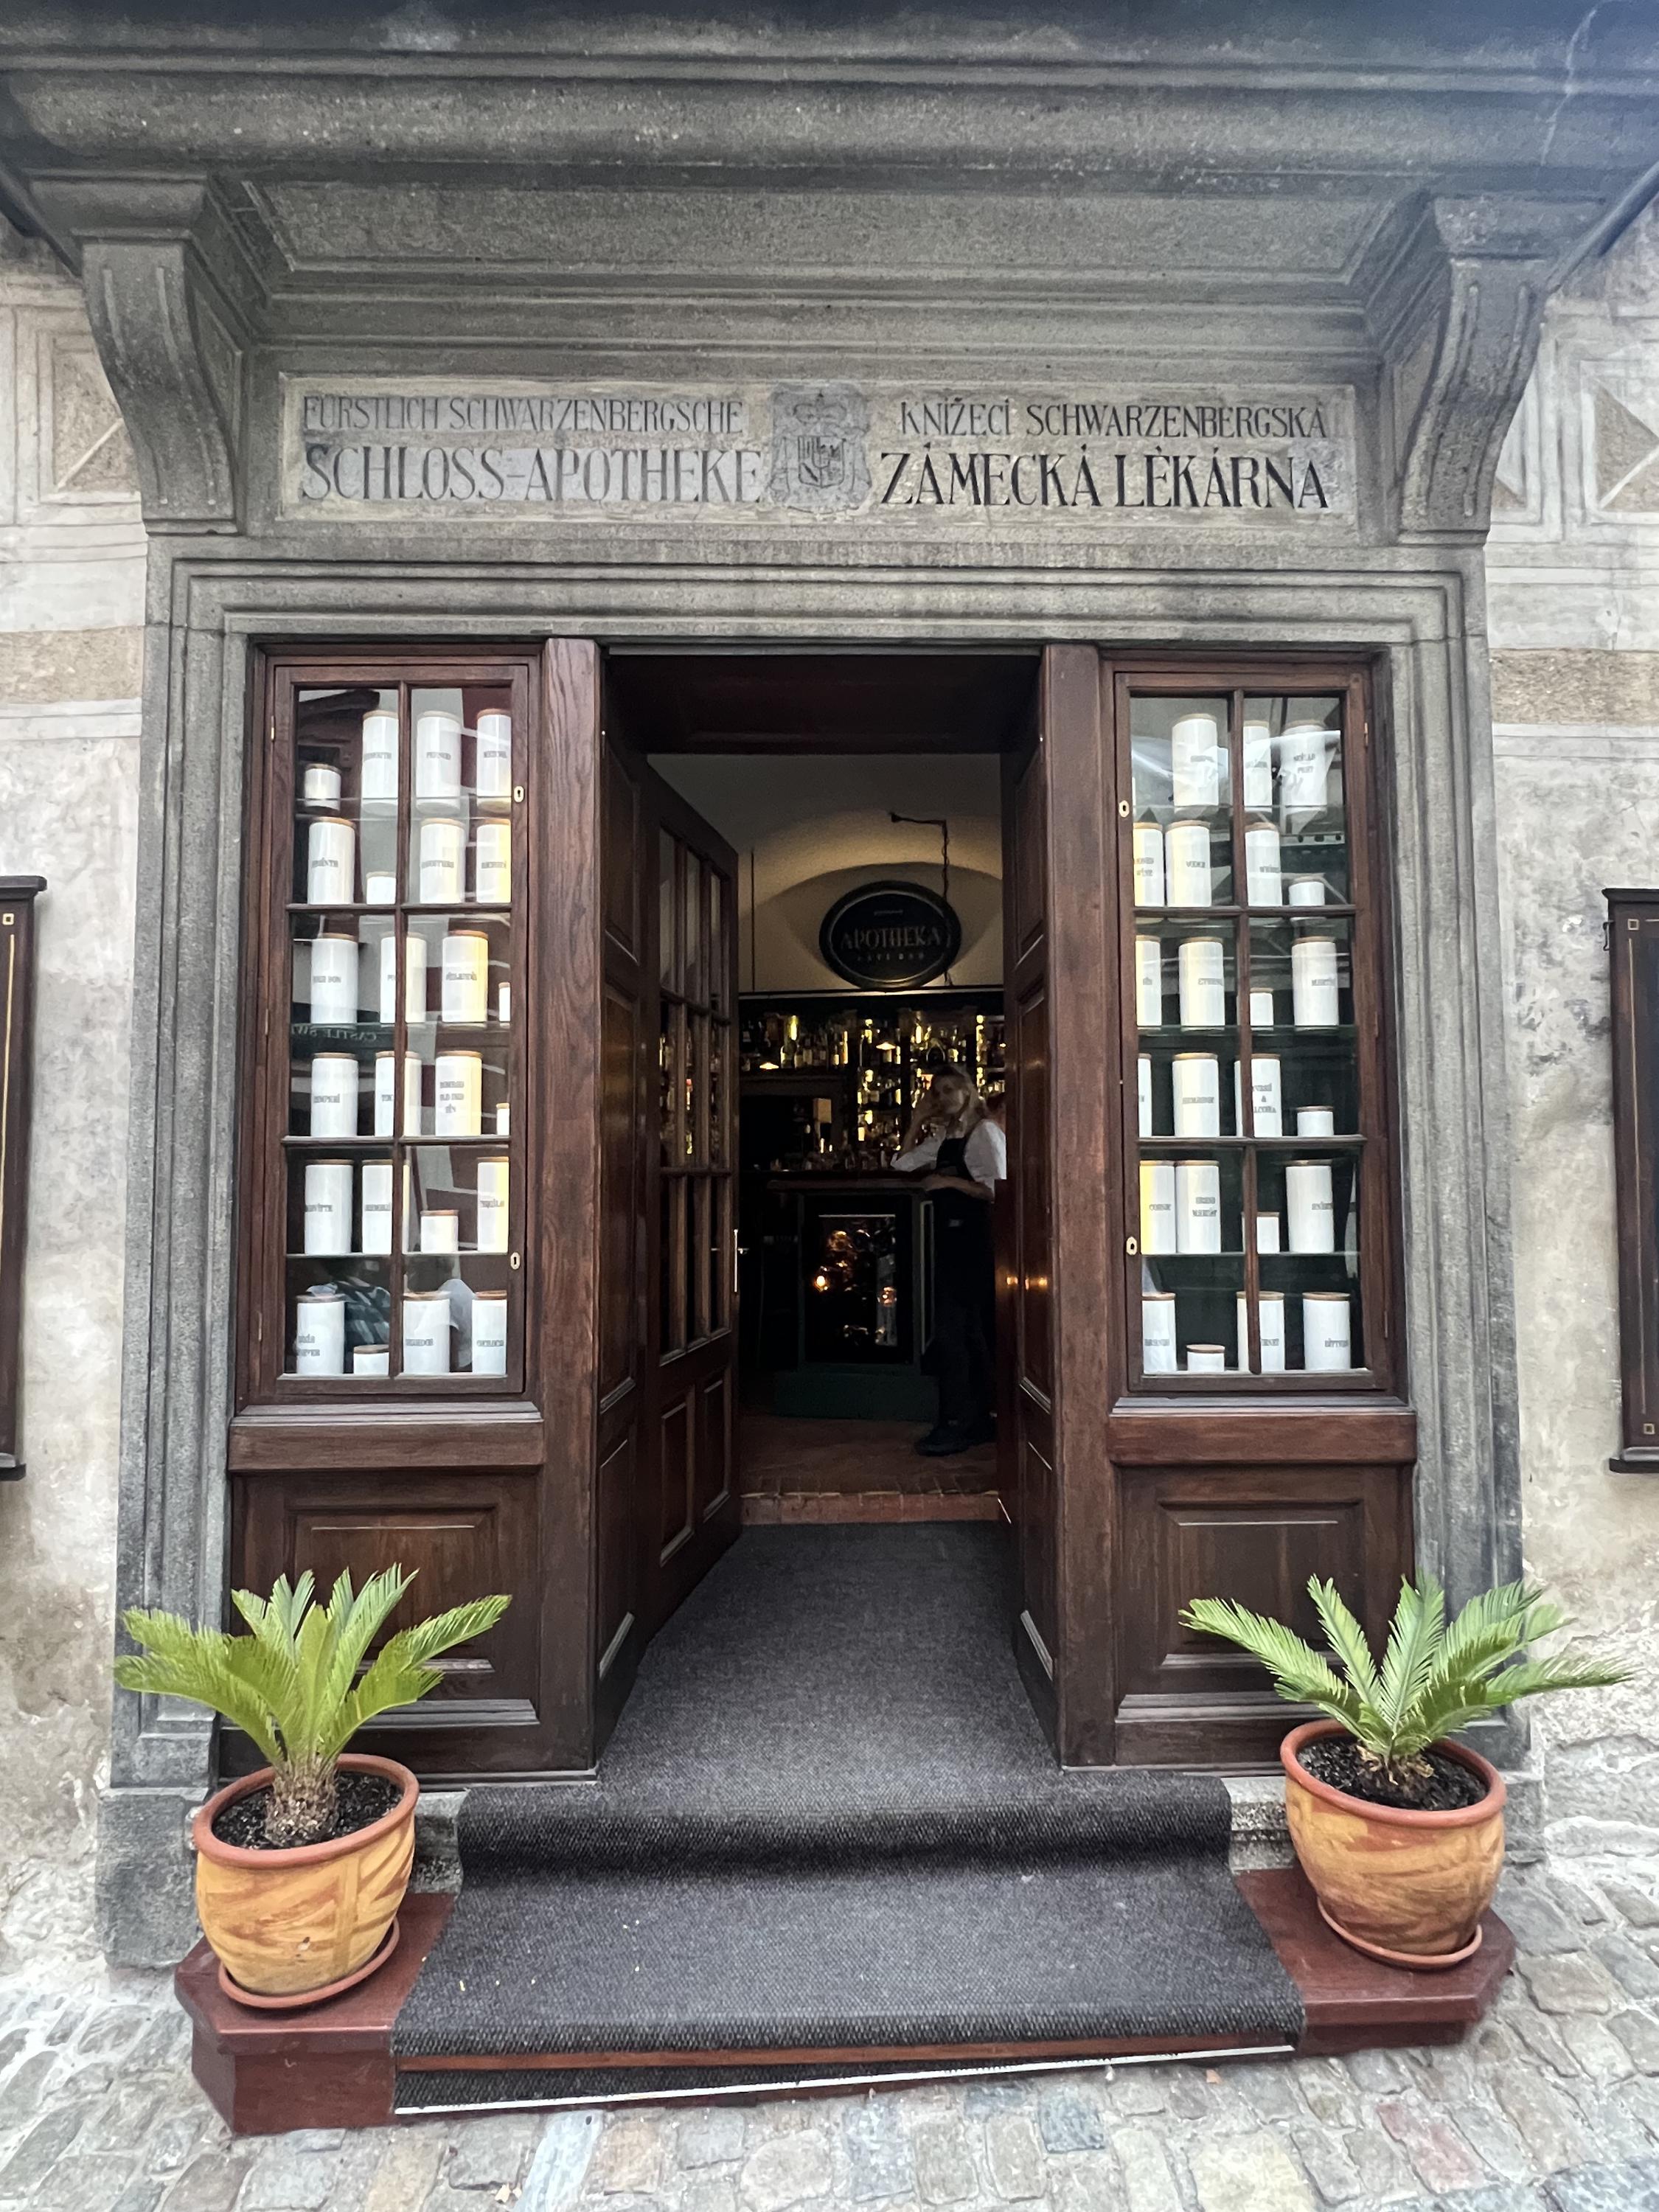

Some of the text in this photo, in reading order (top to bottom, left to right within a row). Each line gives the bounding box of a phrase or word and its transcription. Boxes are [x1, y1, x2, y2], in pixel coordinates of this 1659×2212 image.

[450, 396, 743, 434] SCHWARZENBERGSCHE
[302, 444, 762, 504] SCHLOSS-APOTHEKE
[880, 442, 1102, 507] ZÁMECKÁ
